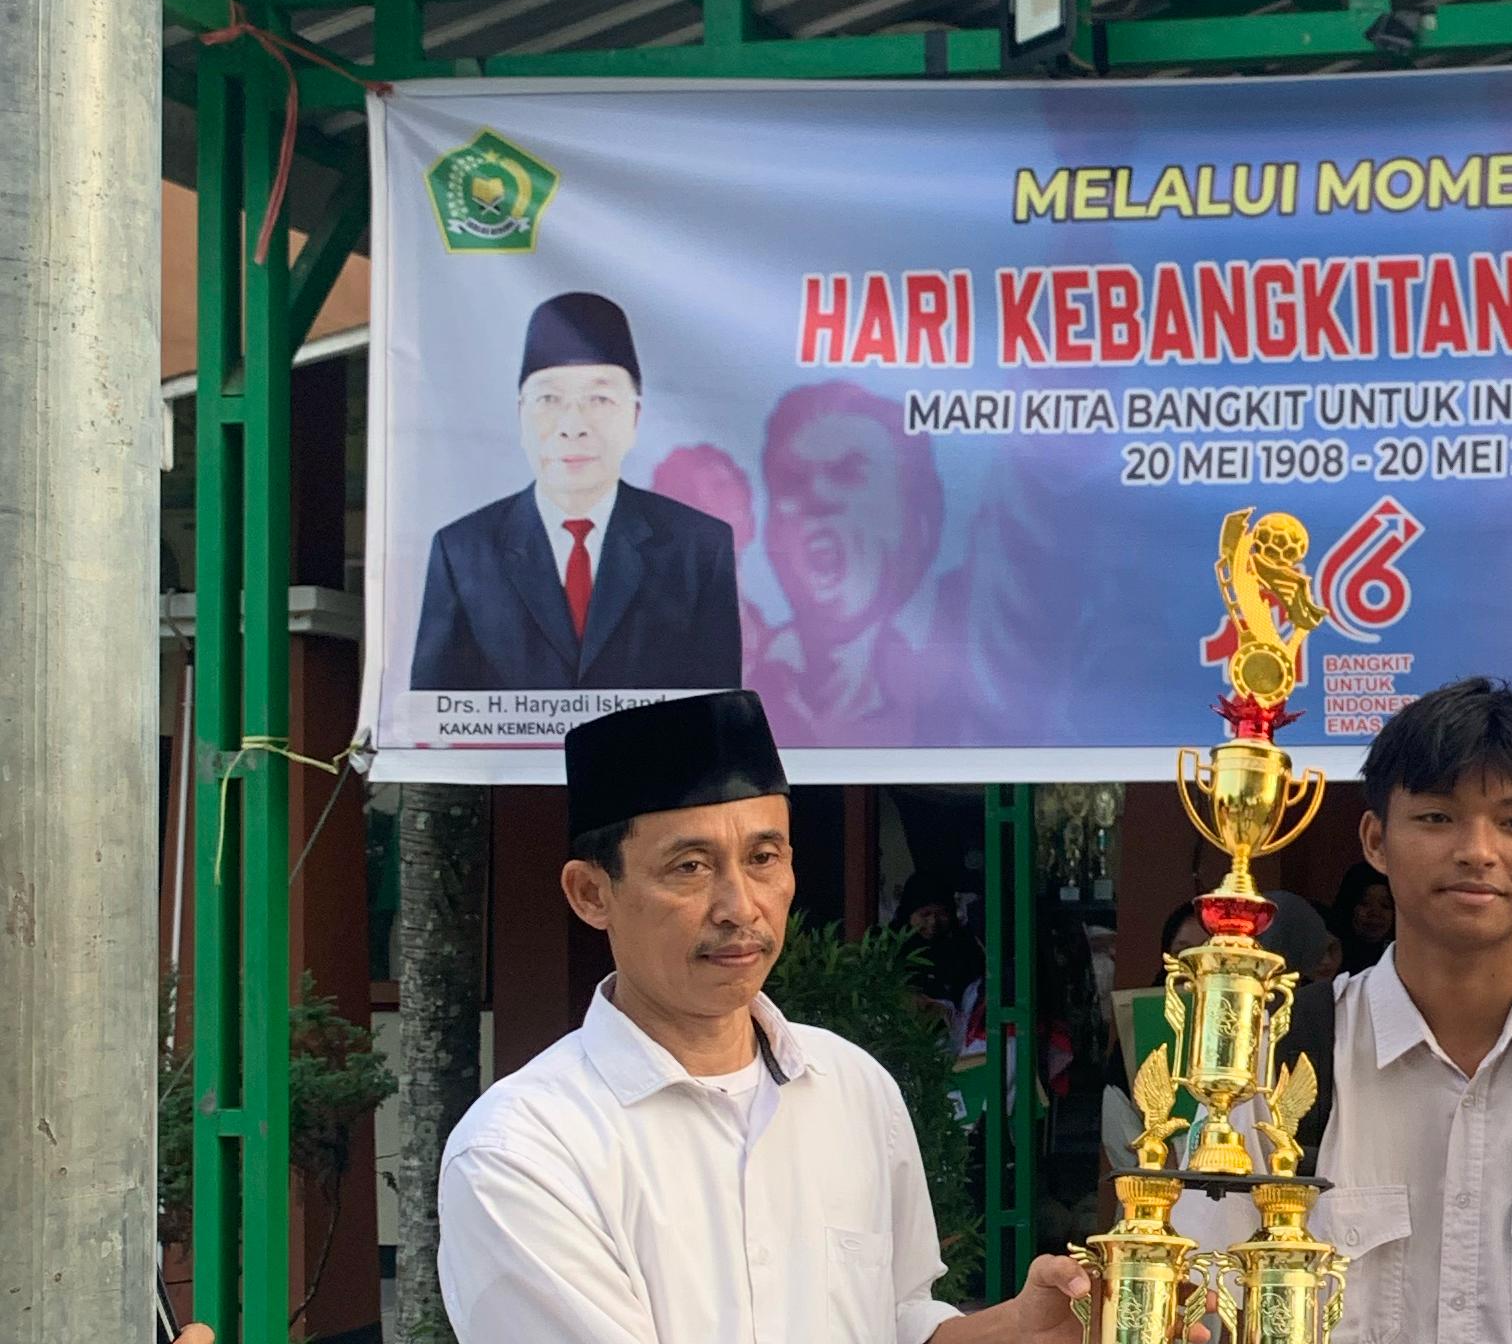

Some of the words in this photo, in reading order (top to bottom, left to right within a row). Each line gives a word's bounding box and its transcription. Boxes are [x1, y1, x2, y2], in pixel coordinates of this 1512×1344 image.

[1013, 162, 1299, 224] MELALUI
[798, 271, 972, 365] HARI
[908, 392, 1011, 431] MARI
[1024, 392, 1114, 430] KITA
[1127, 389, 1305, 429] BANGKIT
[1319, 386, 1460, 426] UNTUK
[1126, 446, 1171, 482] 20
[1183, 444, 1249, 480] MEI
[1260, 443, 1345, 478] 1908
[1380, 441, 1424, 477] 20
[1436, 440, 1503, 475] MEI
[1325, 656, 1412, 672] BANGKIT
[1326, 677, 1393, 692] UNTUK
[437, 695, 481, 714] Drs.
[488, 696, 508, 713] H.
[515, 695, 590, 717] Haryadi
[1326, 696, 1416, 714] INDONES
[439, 722, 493, 735] KAKAN
[497, 722, 566, 735] KEMENAG
[1327, 717, 1382, 733] EMAS
